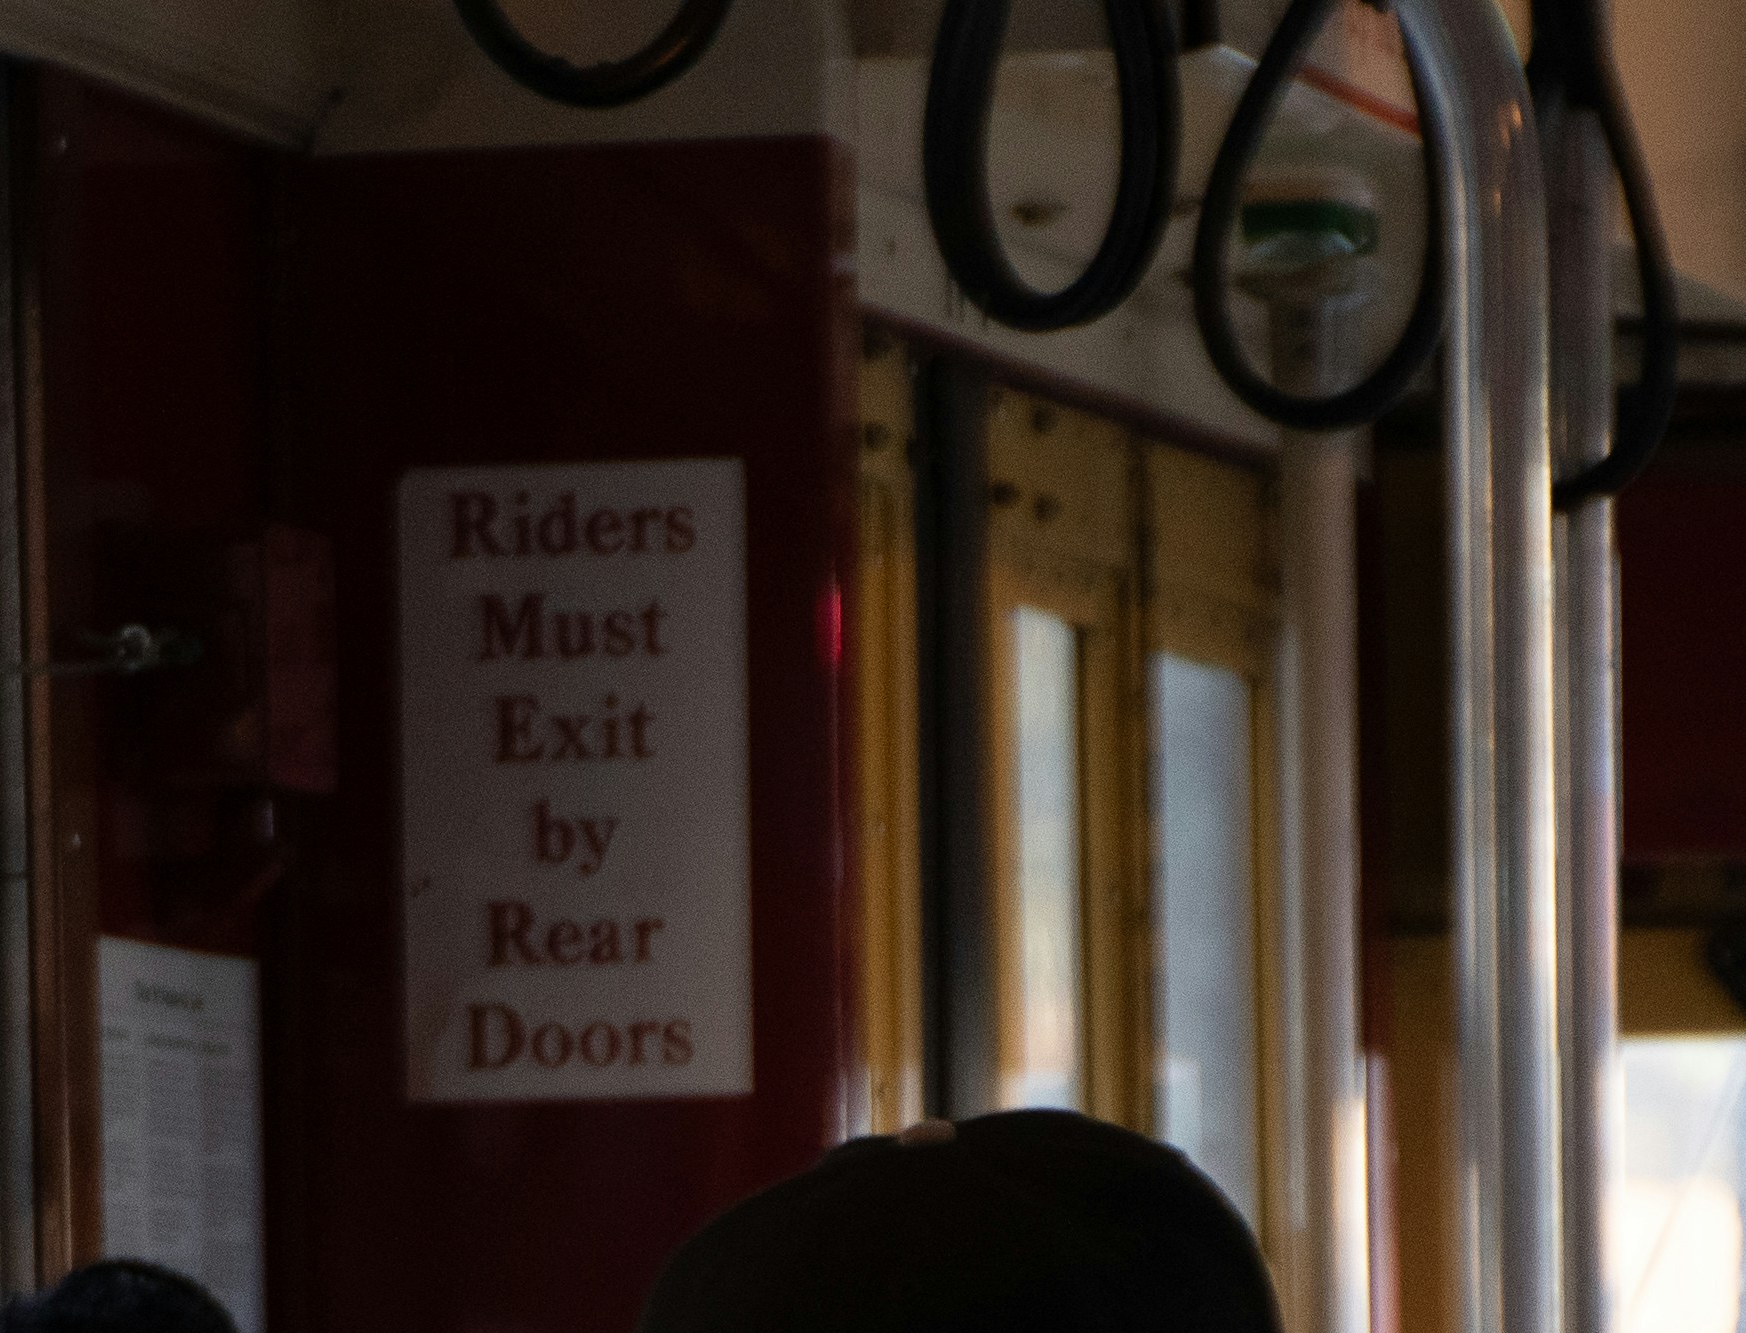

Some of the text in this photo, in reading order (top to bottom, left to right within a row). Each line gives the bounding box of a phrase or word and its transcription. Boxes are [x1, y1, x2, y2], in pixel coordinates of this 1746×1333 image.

[452, 491, 696, 559] Riders
[477, 593, 668, 662] Must
[493, 694, 656, 764] Exit
[533, 801, 619, 875] by
[486, 900, 664, 968] Rear
[467, 1002, 696, 1071] Doors
